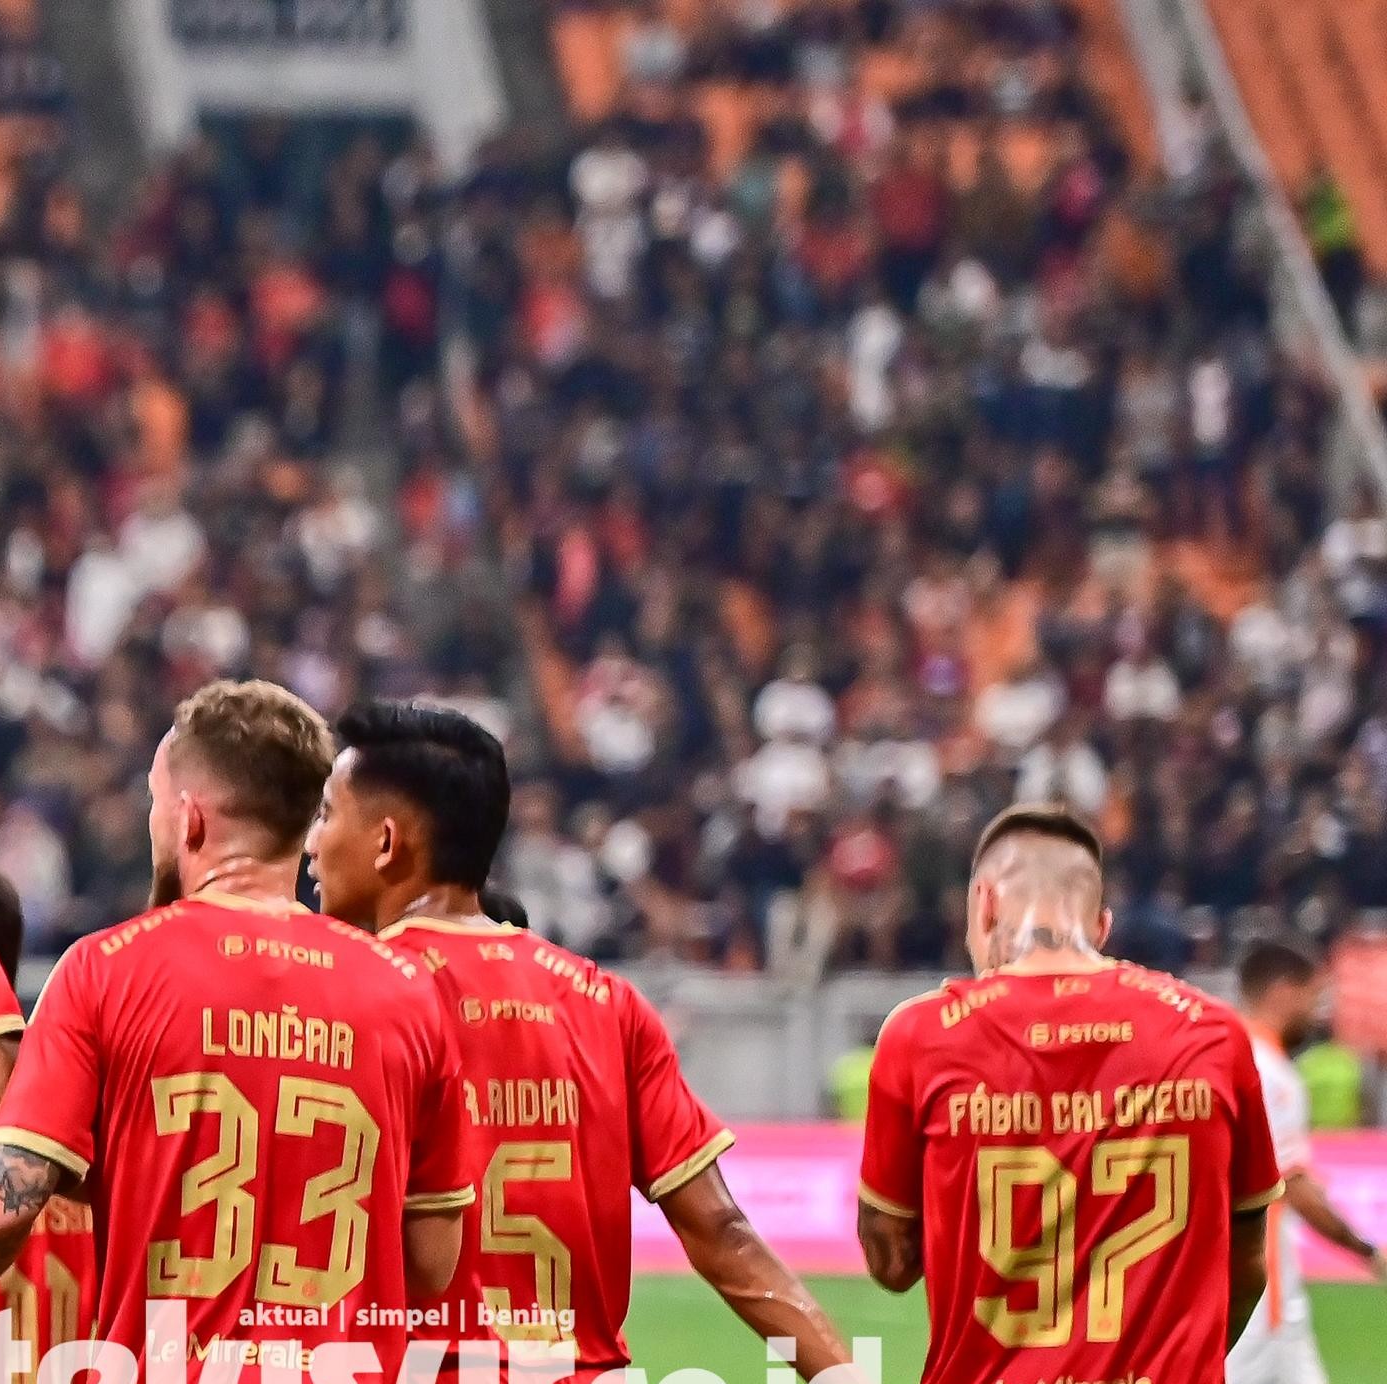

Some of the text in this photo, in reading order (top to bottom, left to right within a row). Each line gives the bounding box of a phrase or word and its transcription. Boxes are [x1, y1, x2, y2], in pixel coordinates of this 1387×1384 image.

[256, 938, 334, 970] PSTORE
[202, 1003, 354, 1070] LONČAR
[1059, 1021, 1134, 1045] PSTORE
[948, 1082, 1042, 1137] FÁBIO
[147, 1071, 380, 1310] 33
[480, 1140, 580, 1360] 5
[974, 1135, 1189, 1348] 97
